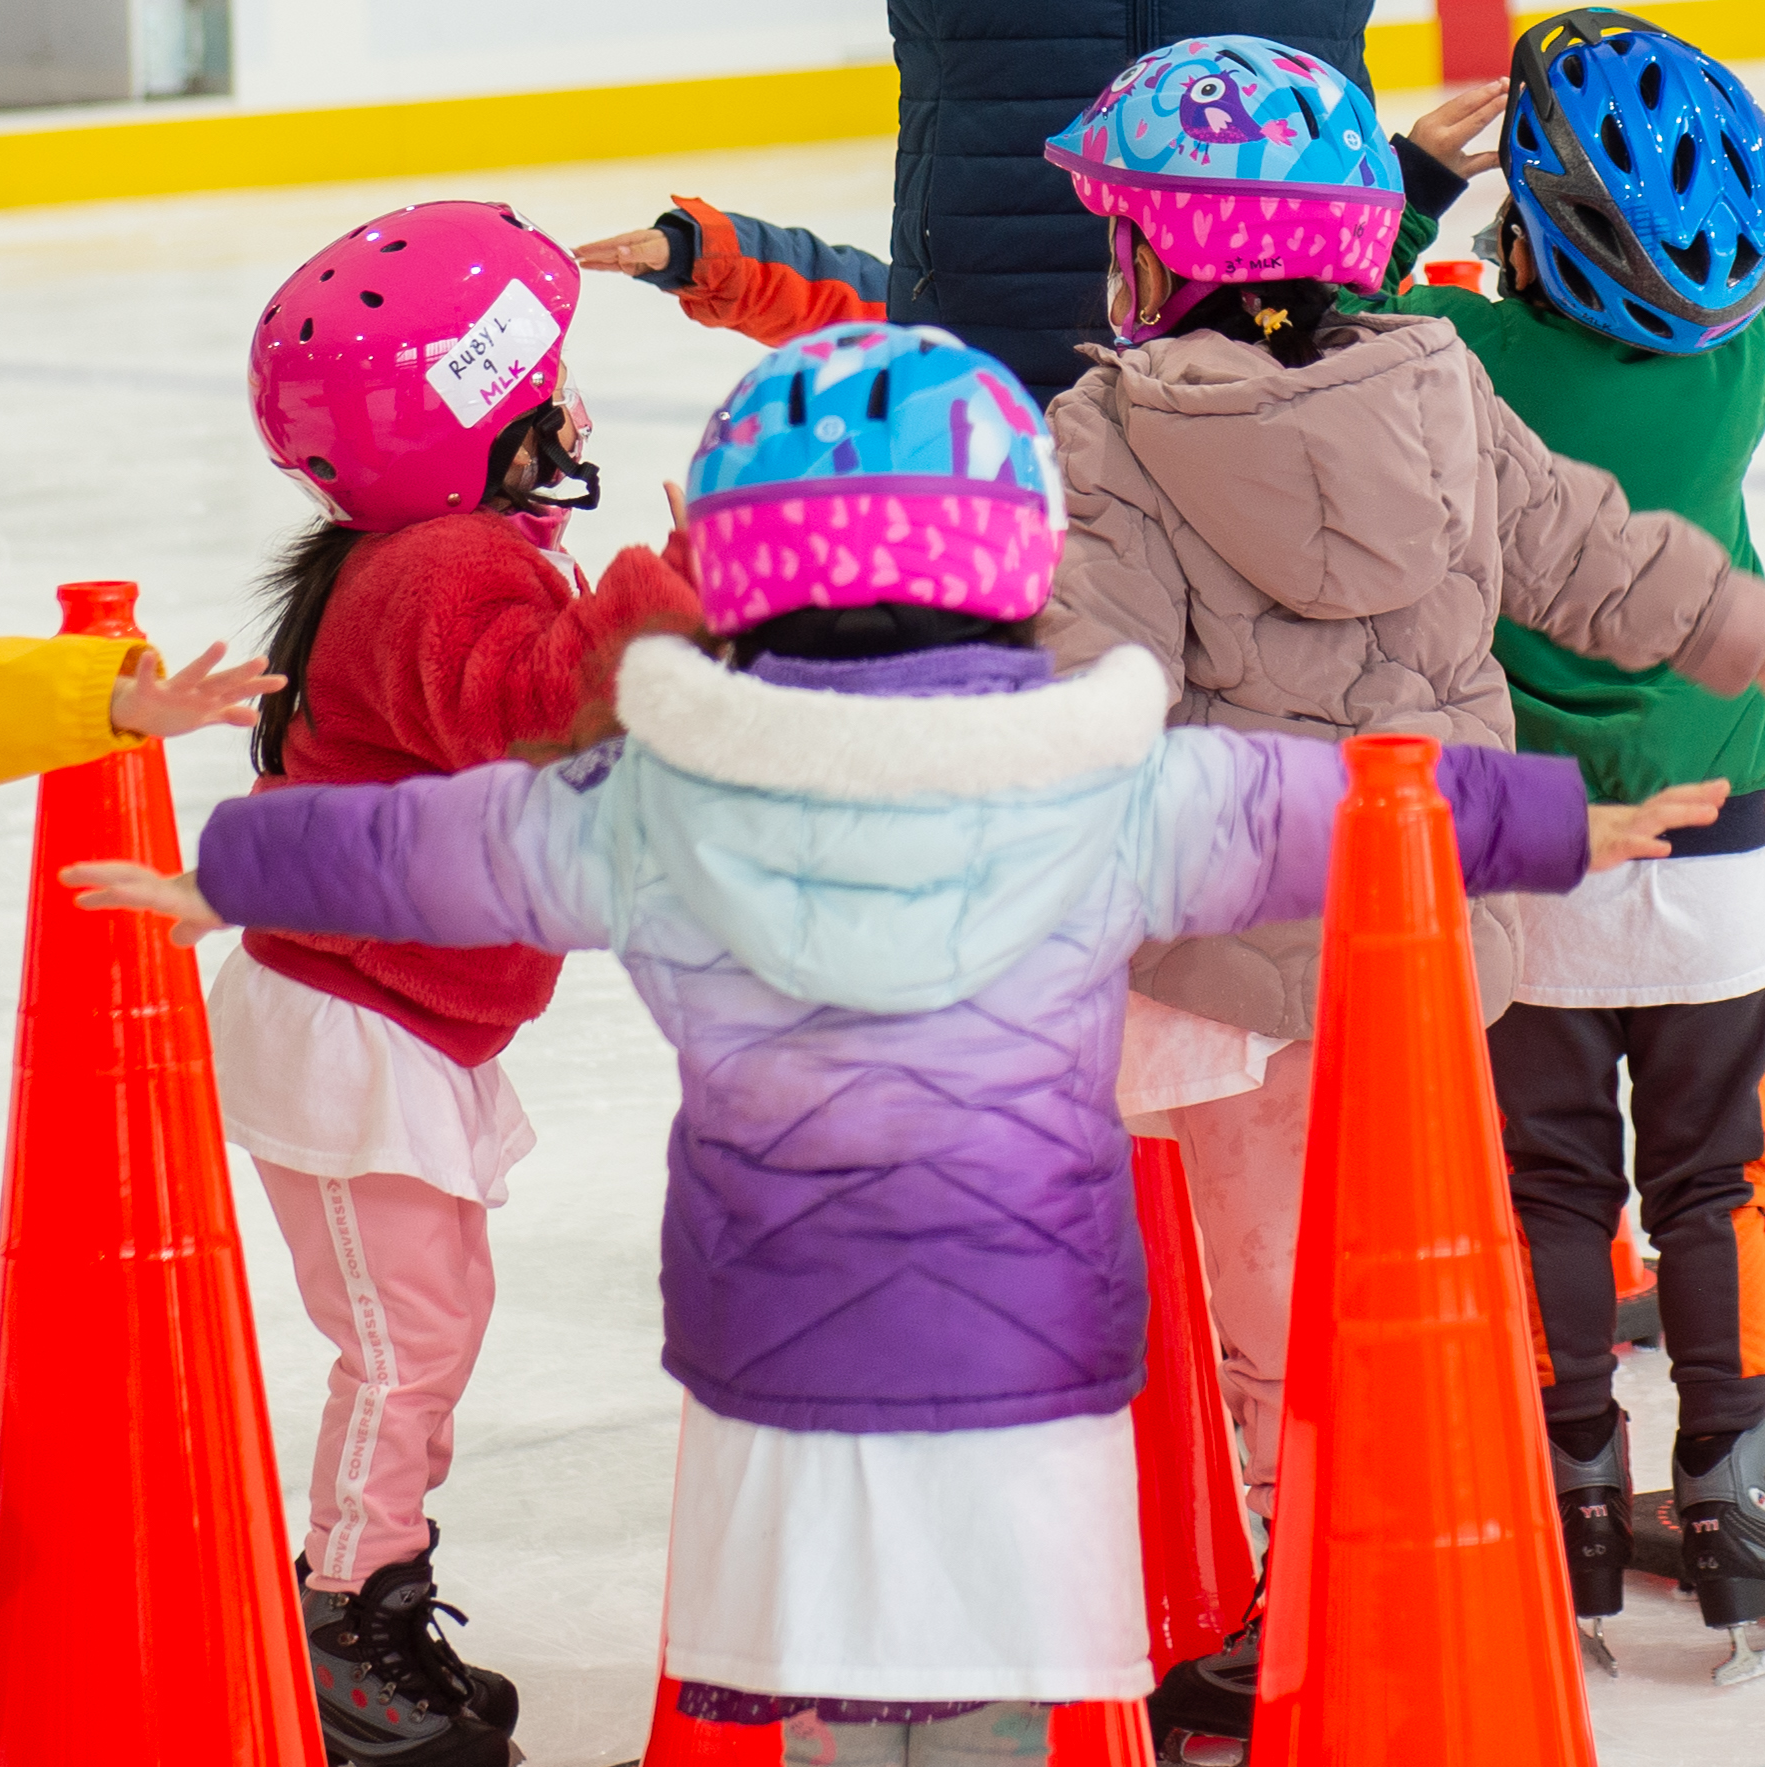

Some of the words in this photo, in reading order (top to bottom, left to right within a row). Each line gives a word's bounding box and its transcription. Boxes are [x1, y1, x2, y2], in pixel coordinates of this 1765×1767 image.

[1249, 256, 1283, 270] MLK
[448, 326, 495, 380] RUBY
[483, 358, 498, 374] 9
[479, 359, 527, 406] MLK
[331, 1194, 362, 1280] CONVERSE
[348, 1398, 375, 1481] CONVERSE
